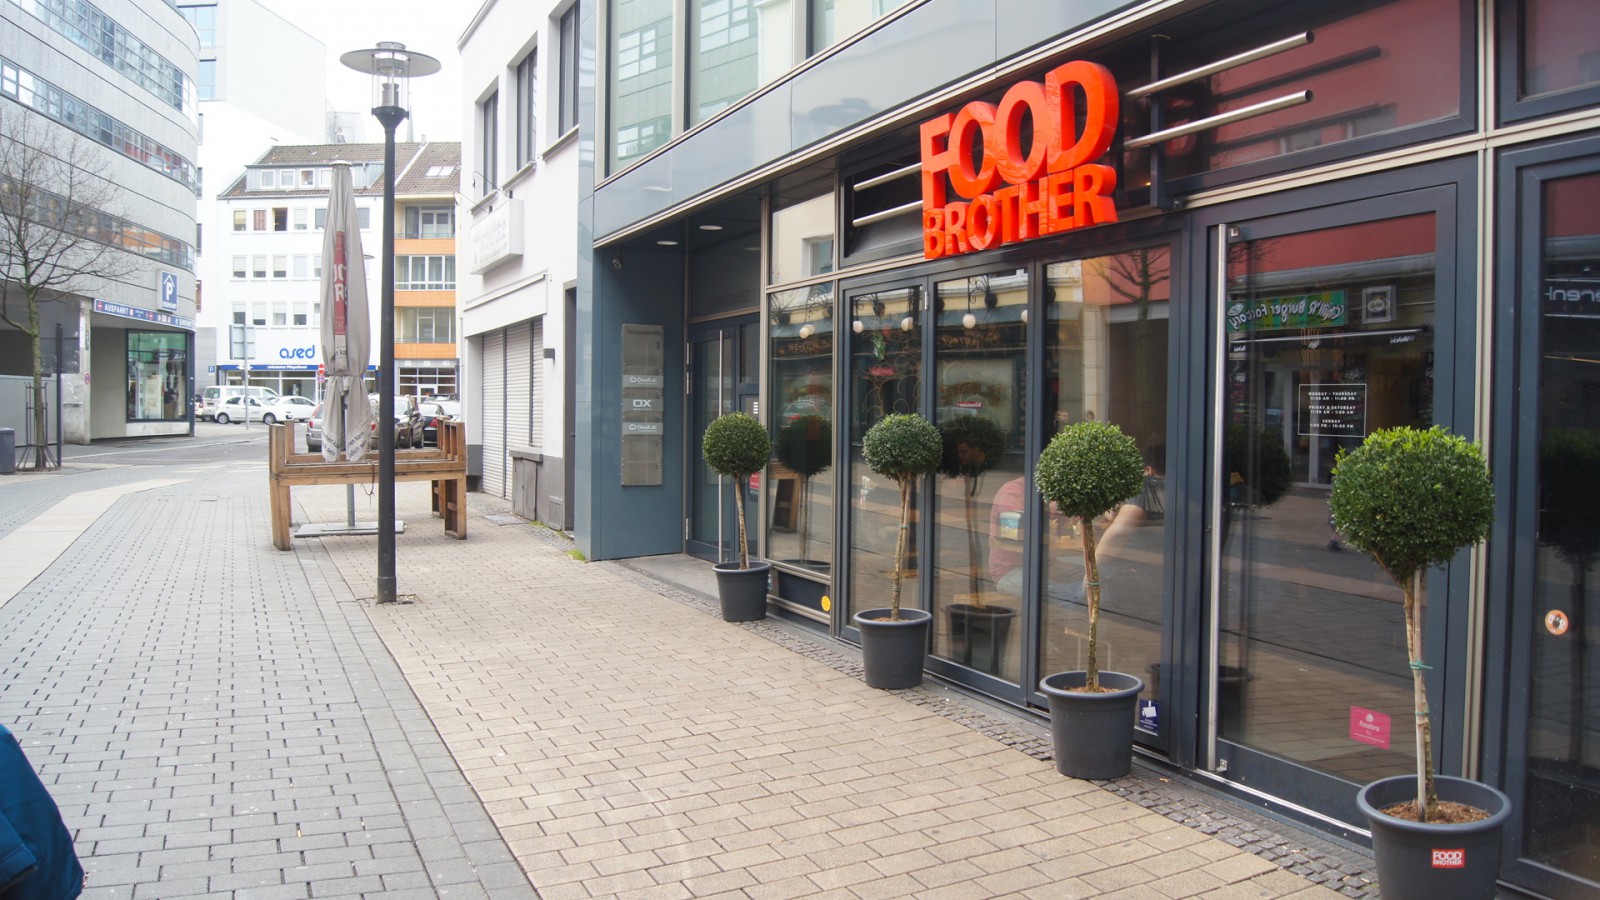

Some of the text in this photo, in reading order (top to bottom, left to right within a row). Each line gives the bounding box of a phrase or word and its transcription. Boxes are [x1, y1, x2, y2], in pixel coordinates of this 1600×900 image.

[919, 60, 1119, 212] FOOD
[922, 163, 1118, 260] BROTHER
[166, 282, 174, 301] P
[104, 303, 129, 315] AUSFAHRT
[279, 345, 316, 359] ased
[633, 399, 652, 408] OX
[1359, 720, 1380, 732] foodora
[1433, 851, 1462, 861] FOOD
